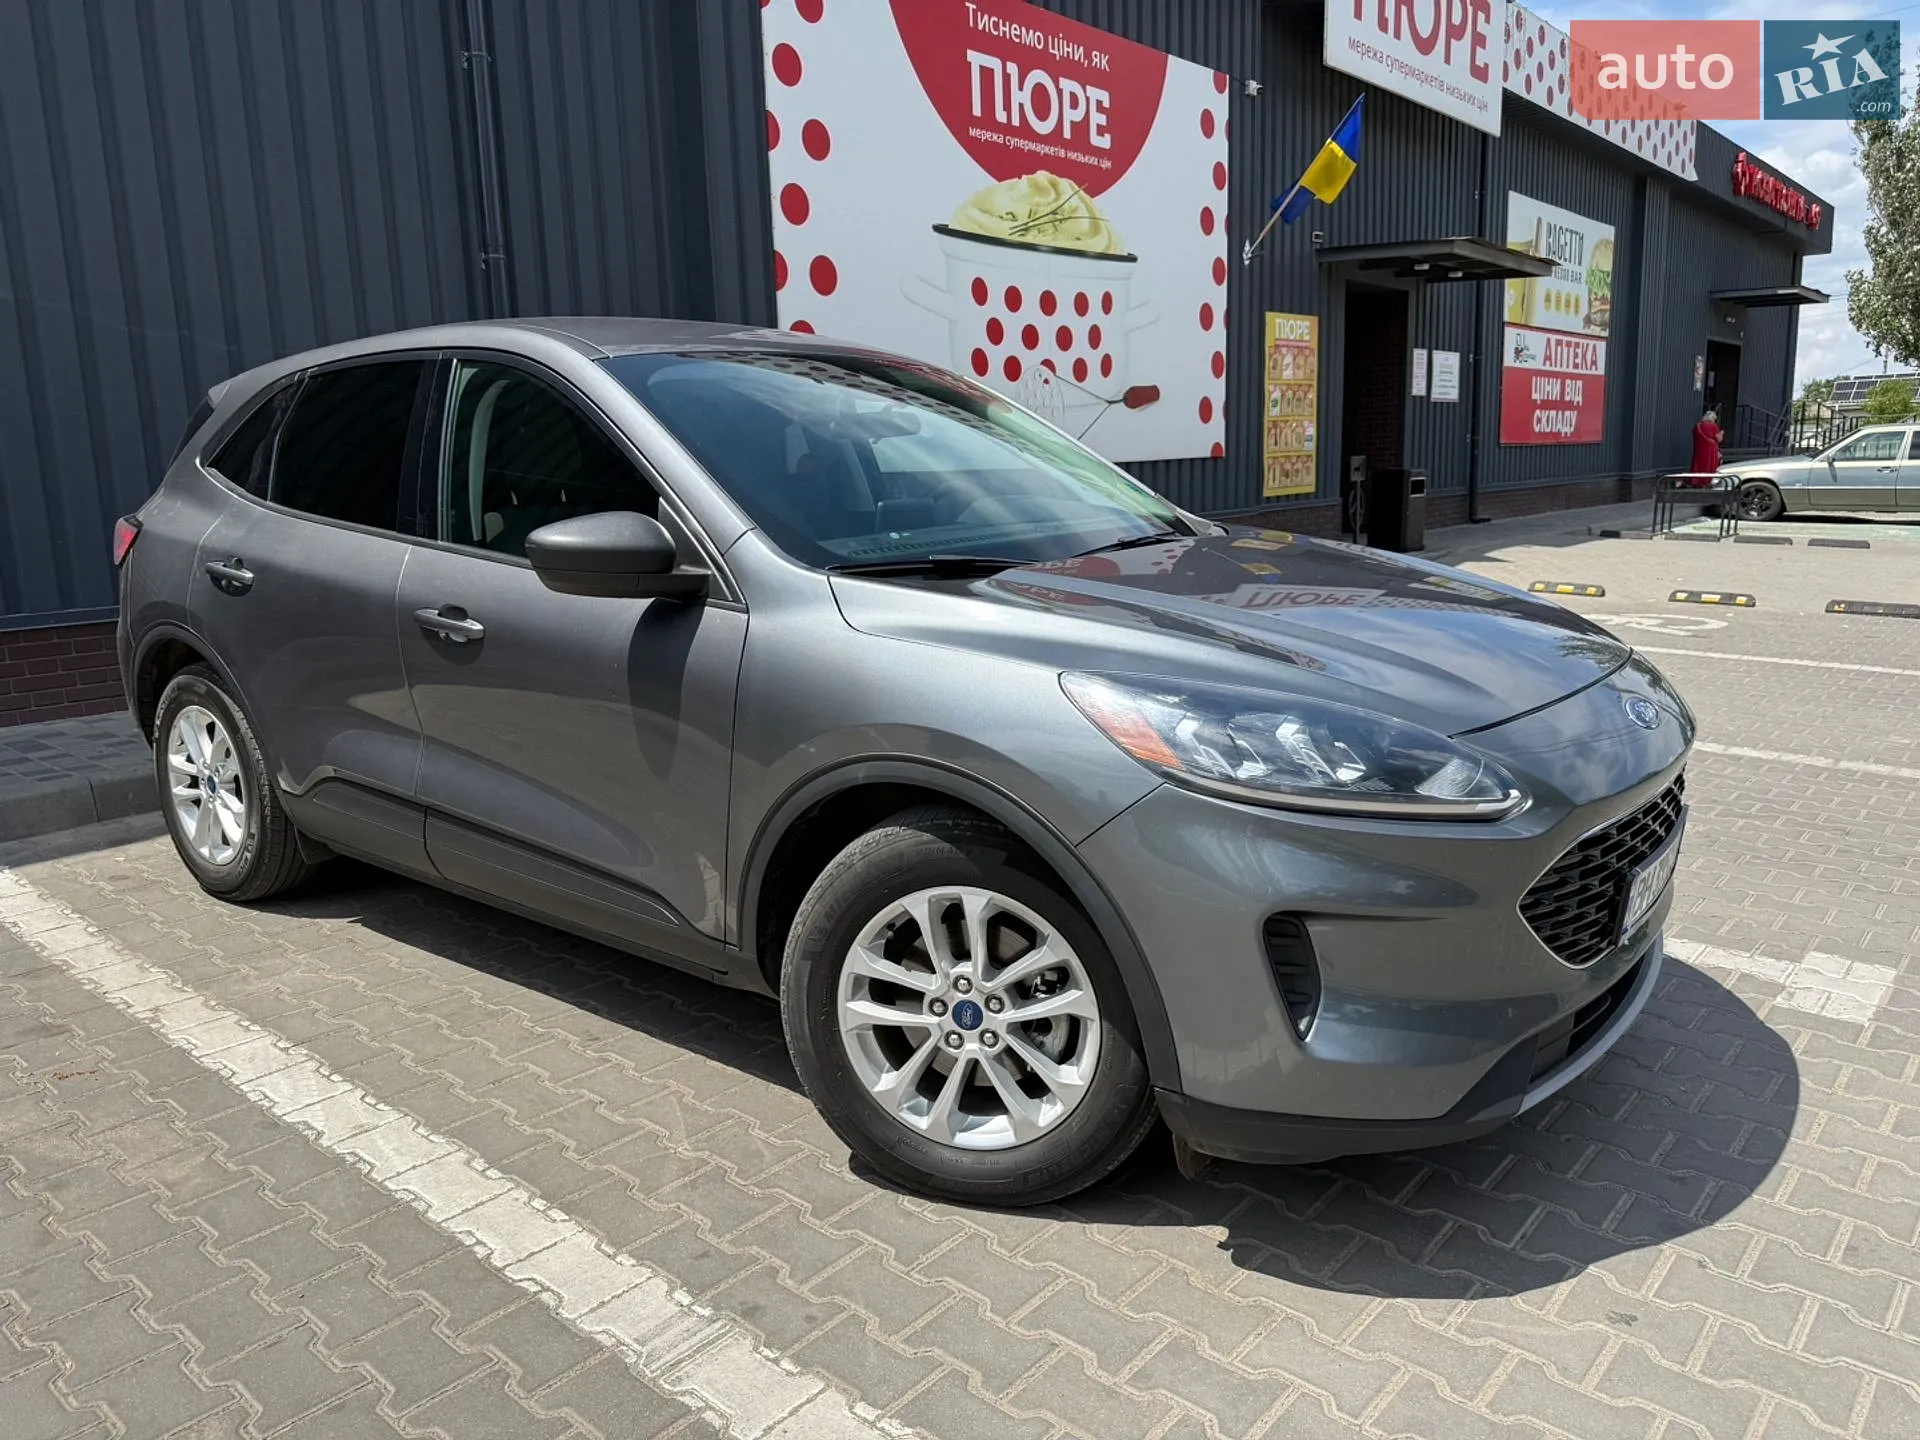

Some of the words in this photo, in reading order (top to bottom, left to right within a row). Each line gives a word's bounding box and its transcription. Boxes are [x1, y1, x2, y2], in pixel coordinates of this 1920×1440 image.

[965, 2, 1044, 49] Тиснемо
[1048, 33, 1088, 67] ціни,
[1091, 51, 1110, 72] як
[1348, 36, 1383, 63] мережа
[1385, 53, 1444, 91] супермаркетів
[966, 48, 1111, 150] ПЮРЕ
[969, 126, 1004, 143] мережа
[1005, 135, 1066, 158] супермаркетів
[1275, 318, 1310, 341] ПЮРЕ
[1543, 337, 1598, 371] АПТЕКА
[1531, 376, 1561, 404] ЦІНИ
[1564, 379, 1583, 406] ВІД
[1533, 409, 1577, 437] СКЛАДУ
